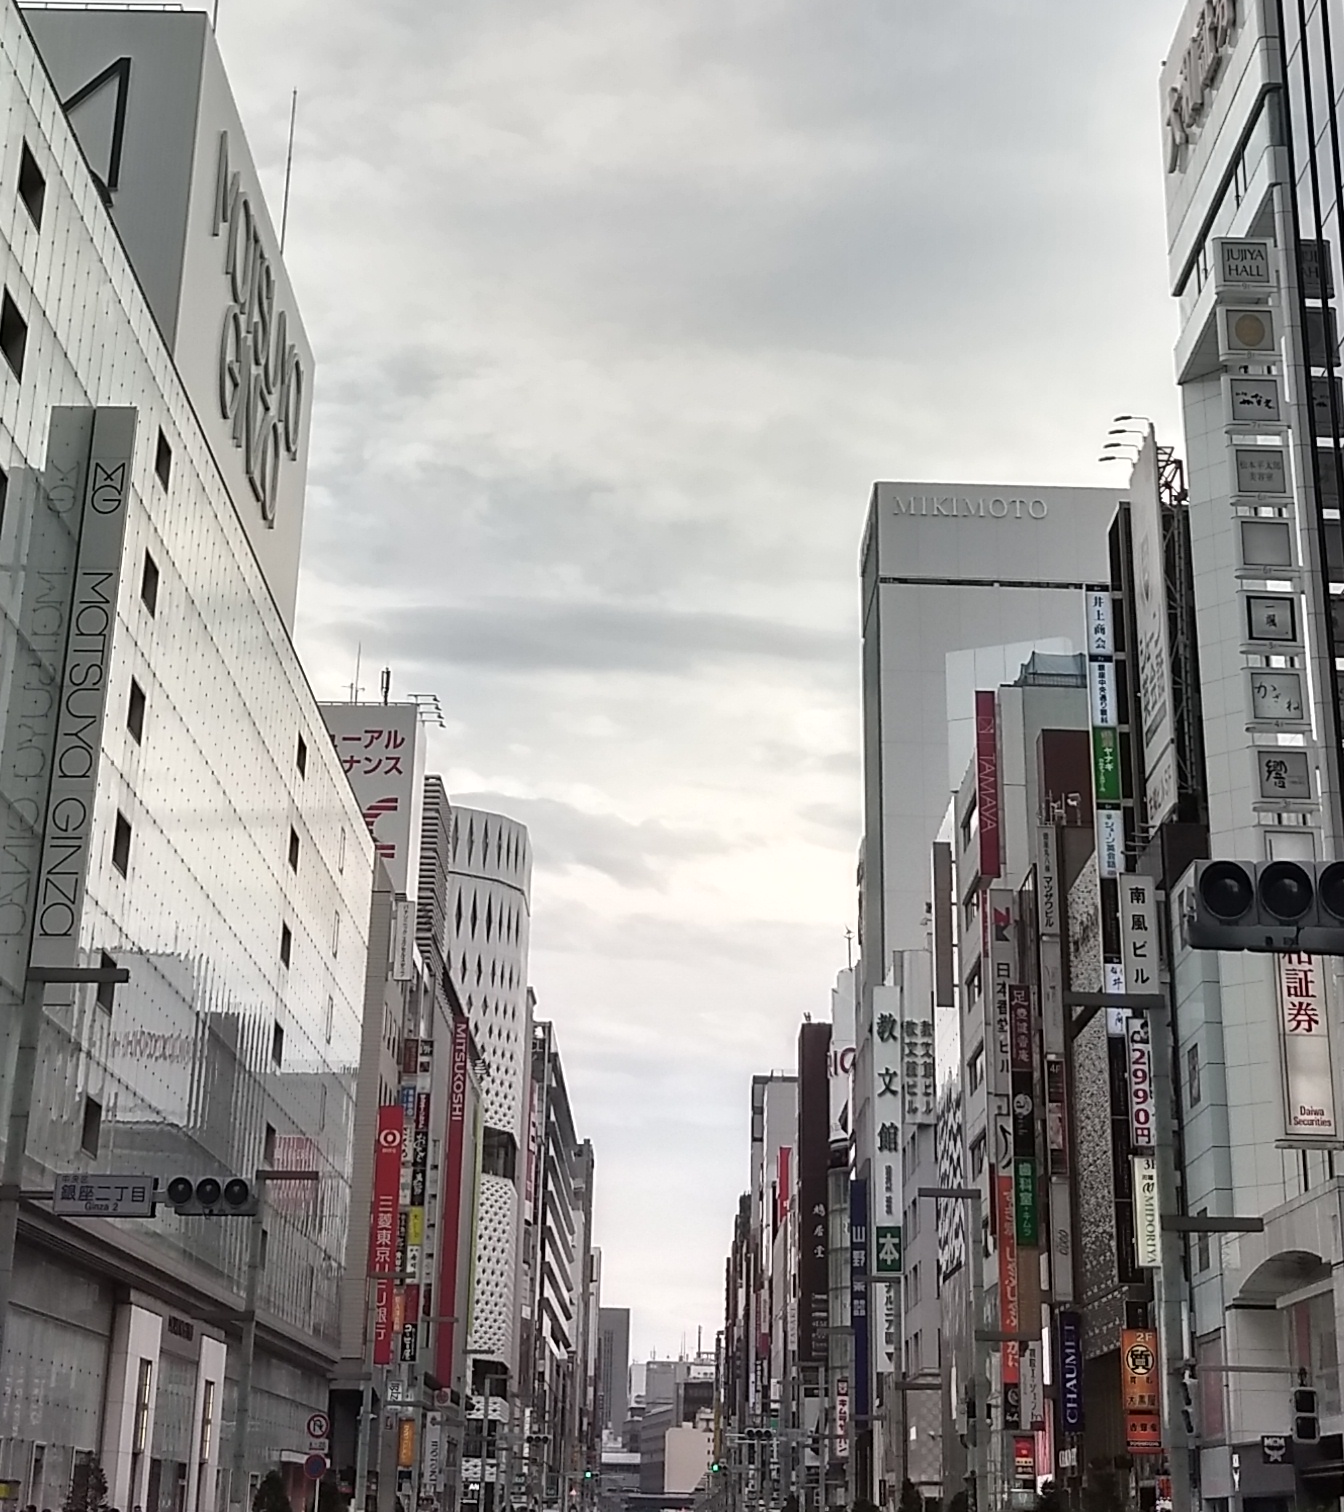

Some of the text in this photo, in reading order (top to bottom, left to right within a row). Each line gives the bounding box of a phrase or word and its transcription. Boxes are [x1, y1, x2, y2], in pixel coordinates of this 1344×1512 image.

[1227, 249, 1265, 262] JUJIYA
[1228, 264, 1263, 277] HALL
[893, 496, 1049, 520] MIKIMOTO
[979, 753, 997, 833] TAMAYA
[1129, 886, 1150, 985] 南風ビル
[451, 1022, 467, 1121] MITSUKOSHI
[876, 1012, 899, 1153] 教文館
[1131, 1048, 1152, 1145] 2990円
[1300, 1105, 1324, 1117] Daiwa
[1293, 1116, 1332, 1128] Securities
[62, 1175, 89, 1184] 中央区
[60, 1184, 146, 1203] 銀座二丁目
[84, 1202, 119, 1211] Ginza 2
[1144, 1195, 1157, 1264] MIDORIYA
[878, 1233, 900, 1266] 本
[1136, 1332, 1154, 1343] 2F
[1130, 1347, 1150, 1375] 質
[1064, 1325, 1080, 1424] CHAUMET
[1127, 1392, 1157, 1407] 大黒屋
[1263, 1437, 1286, 1447] MCM
